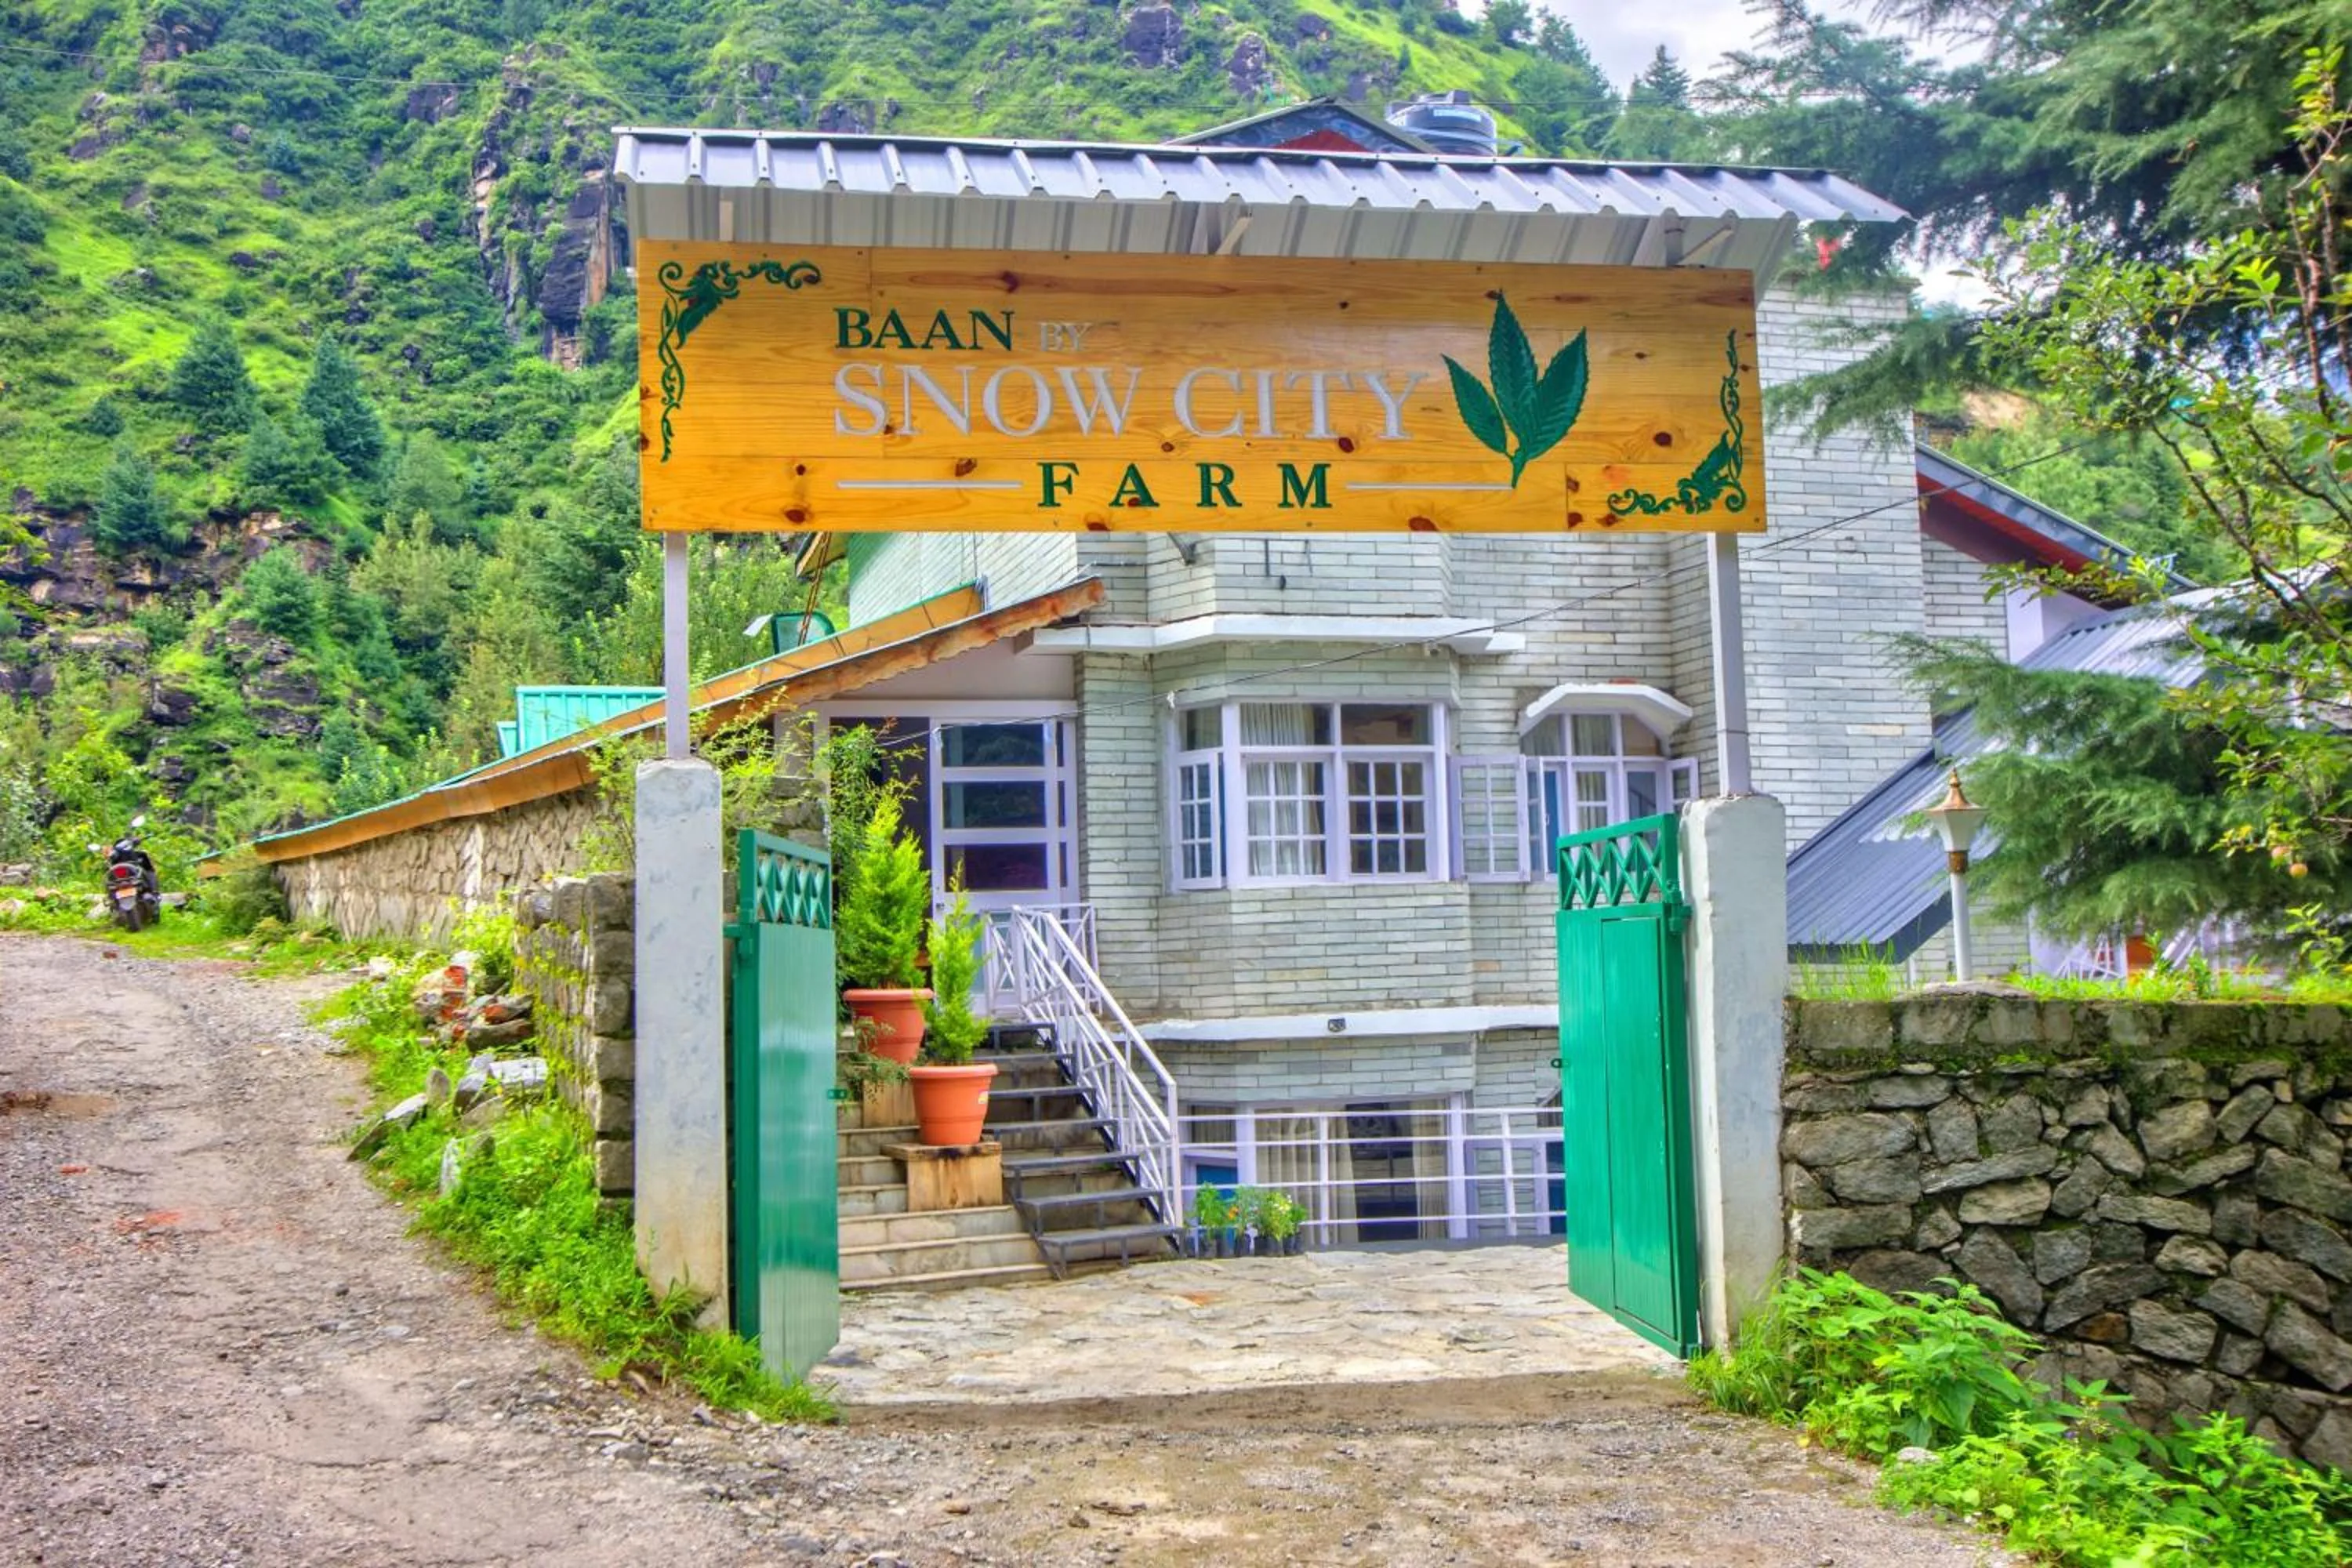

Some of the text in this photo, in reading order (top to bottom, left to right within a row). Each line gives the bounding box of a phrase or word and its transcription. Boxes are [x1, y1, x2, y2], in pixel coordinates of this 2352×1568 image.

[833, 307, 1091, 350] BAAN BY
[833, 363, 1429, 439] SNOW CITY
[1036, 462, 1332, 508] FARM
